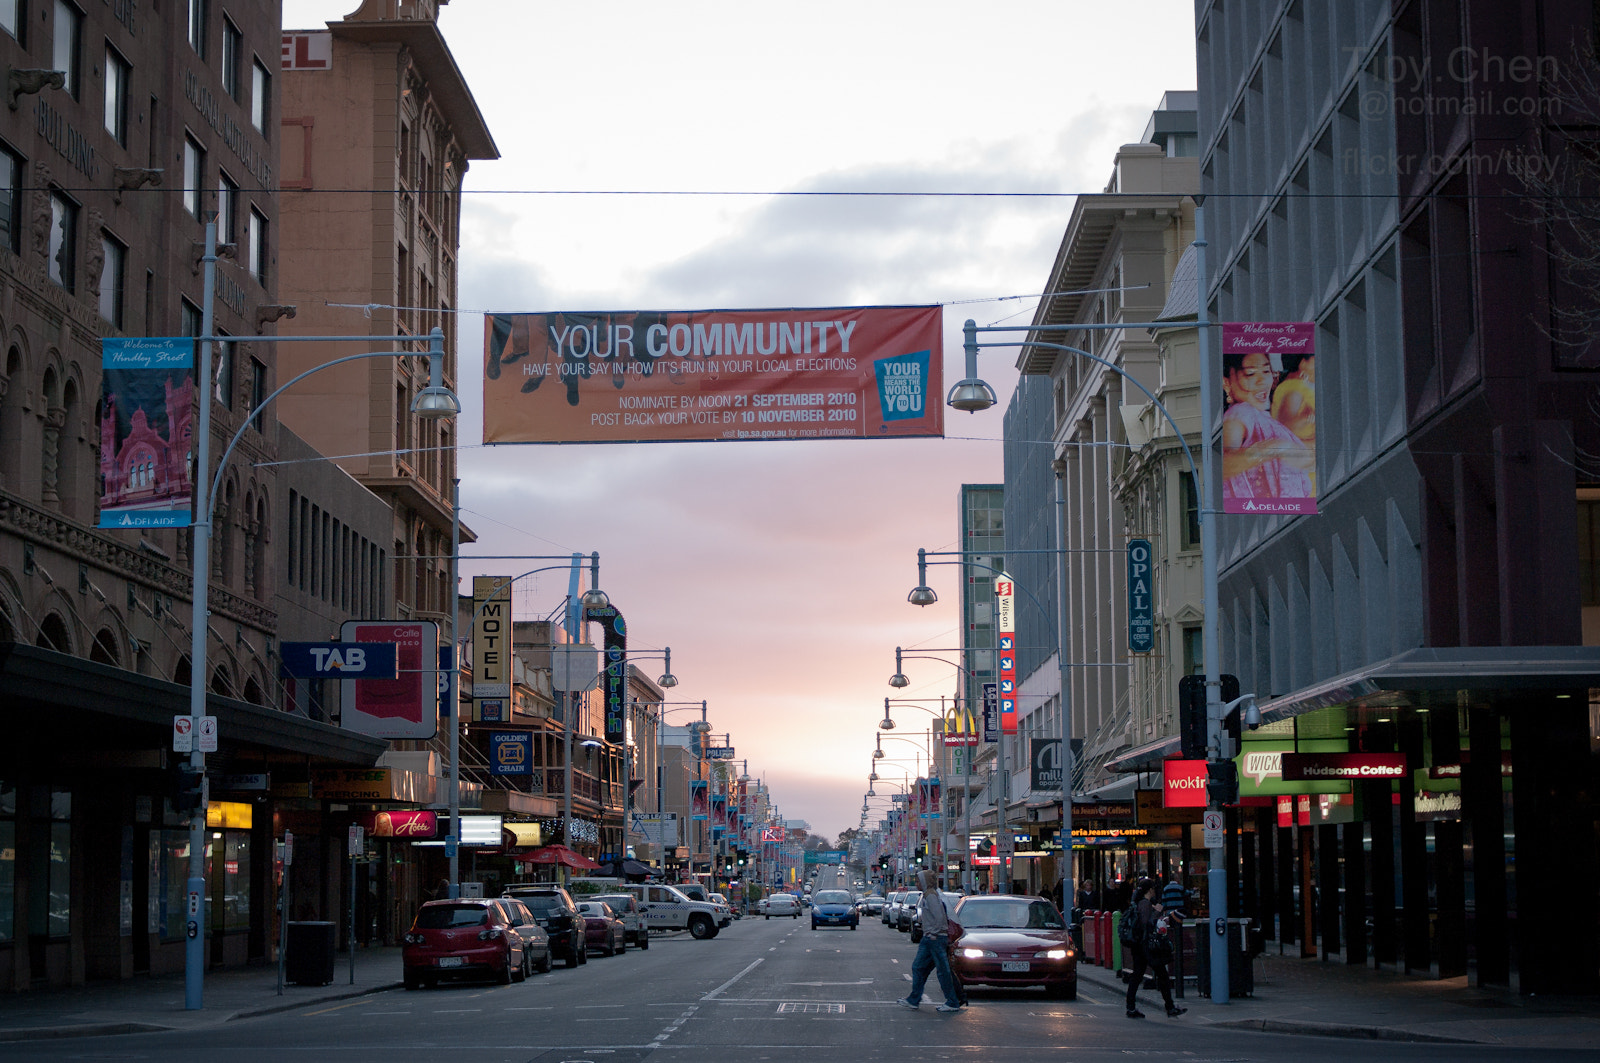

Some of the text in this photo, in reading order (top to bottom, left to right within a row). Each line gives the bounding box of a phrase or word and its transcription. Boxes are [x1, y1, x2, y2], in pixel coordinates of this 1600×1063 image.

[38, 95, 95, 181] BUILDING
[185, 67, 273, 195] COLONIAL MUTUAL LIFE
[214, 263, 246, 319] UILDING
[1242, 323, 1296, 334] Welcome to
[122, 339, 174, 349] Welcome to
[550, 320, 857, 358] YOUR COMMUNITY
[1232, 336, 1309, 352] Hindley Street
[112, 352, 188, 366] Hindley Street
[523, 358, 857, 376] HAVE YOUR SAY IN HOW IT'S RUN IN YOUR LOCAL ELECTIONS
[884, 362, 920, 375] YOUR
[884, 385, 921, 395] WORLD
[619, 392, 857, 409] NOMINATE BY NOON 21 SEPTEMBER 2010
[884, 394, 921, 412] YOU
[591, 408, 857, 426] POST BACK YOUR VOTE BY 10 NOVEMBER 2010
[722, 429, 735, 437] visit
[737, 428, 787, 438] lga.sa.gov.au
[788, 428, 798, 436] for
[819, 427, 857, 436] information
[1244, 500, 1301, 511] ADELAIDE
[120, 513, 176, 526] ADELAIDE
[1132, 546, 1149, 610] OPAL
[1002, 597, 1010, 627] Wilson
[482, 604, 500, 680] MOTEL
[310, 648, 367, 672] TAB
[608, 645, 622, 733] earth
[1004, 701, 1012, 711] P
[1303, 765, 1403, 775] Hudsons Coffee
[323, 790, 380, 798] PIERCING
[1107, 806, 1131, 815] Coffees
[1070, 828, 1087, 836] oria
